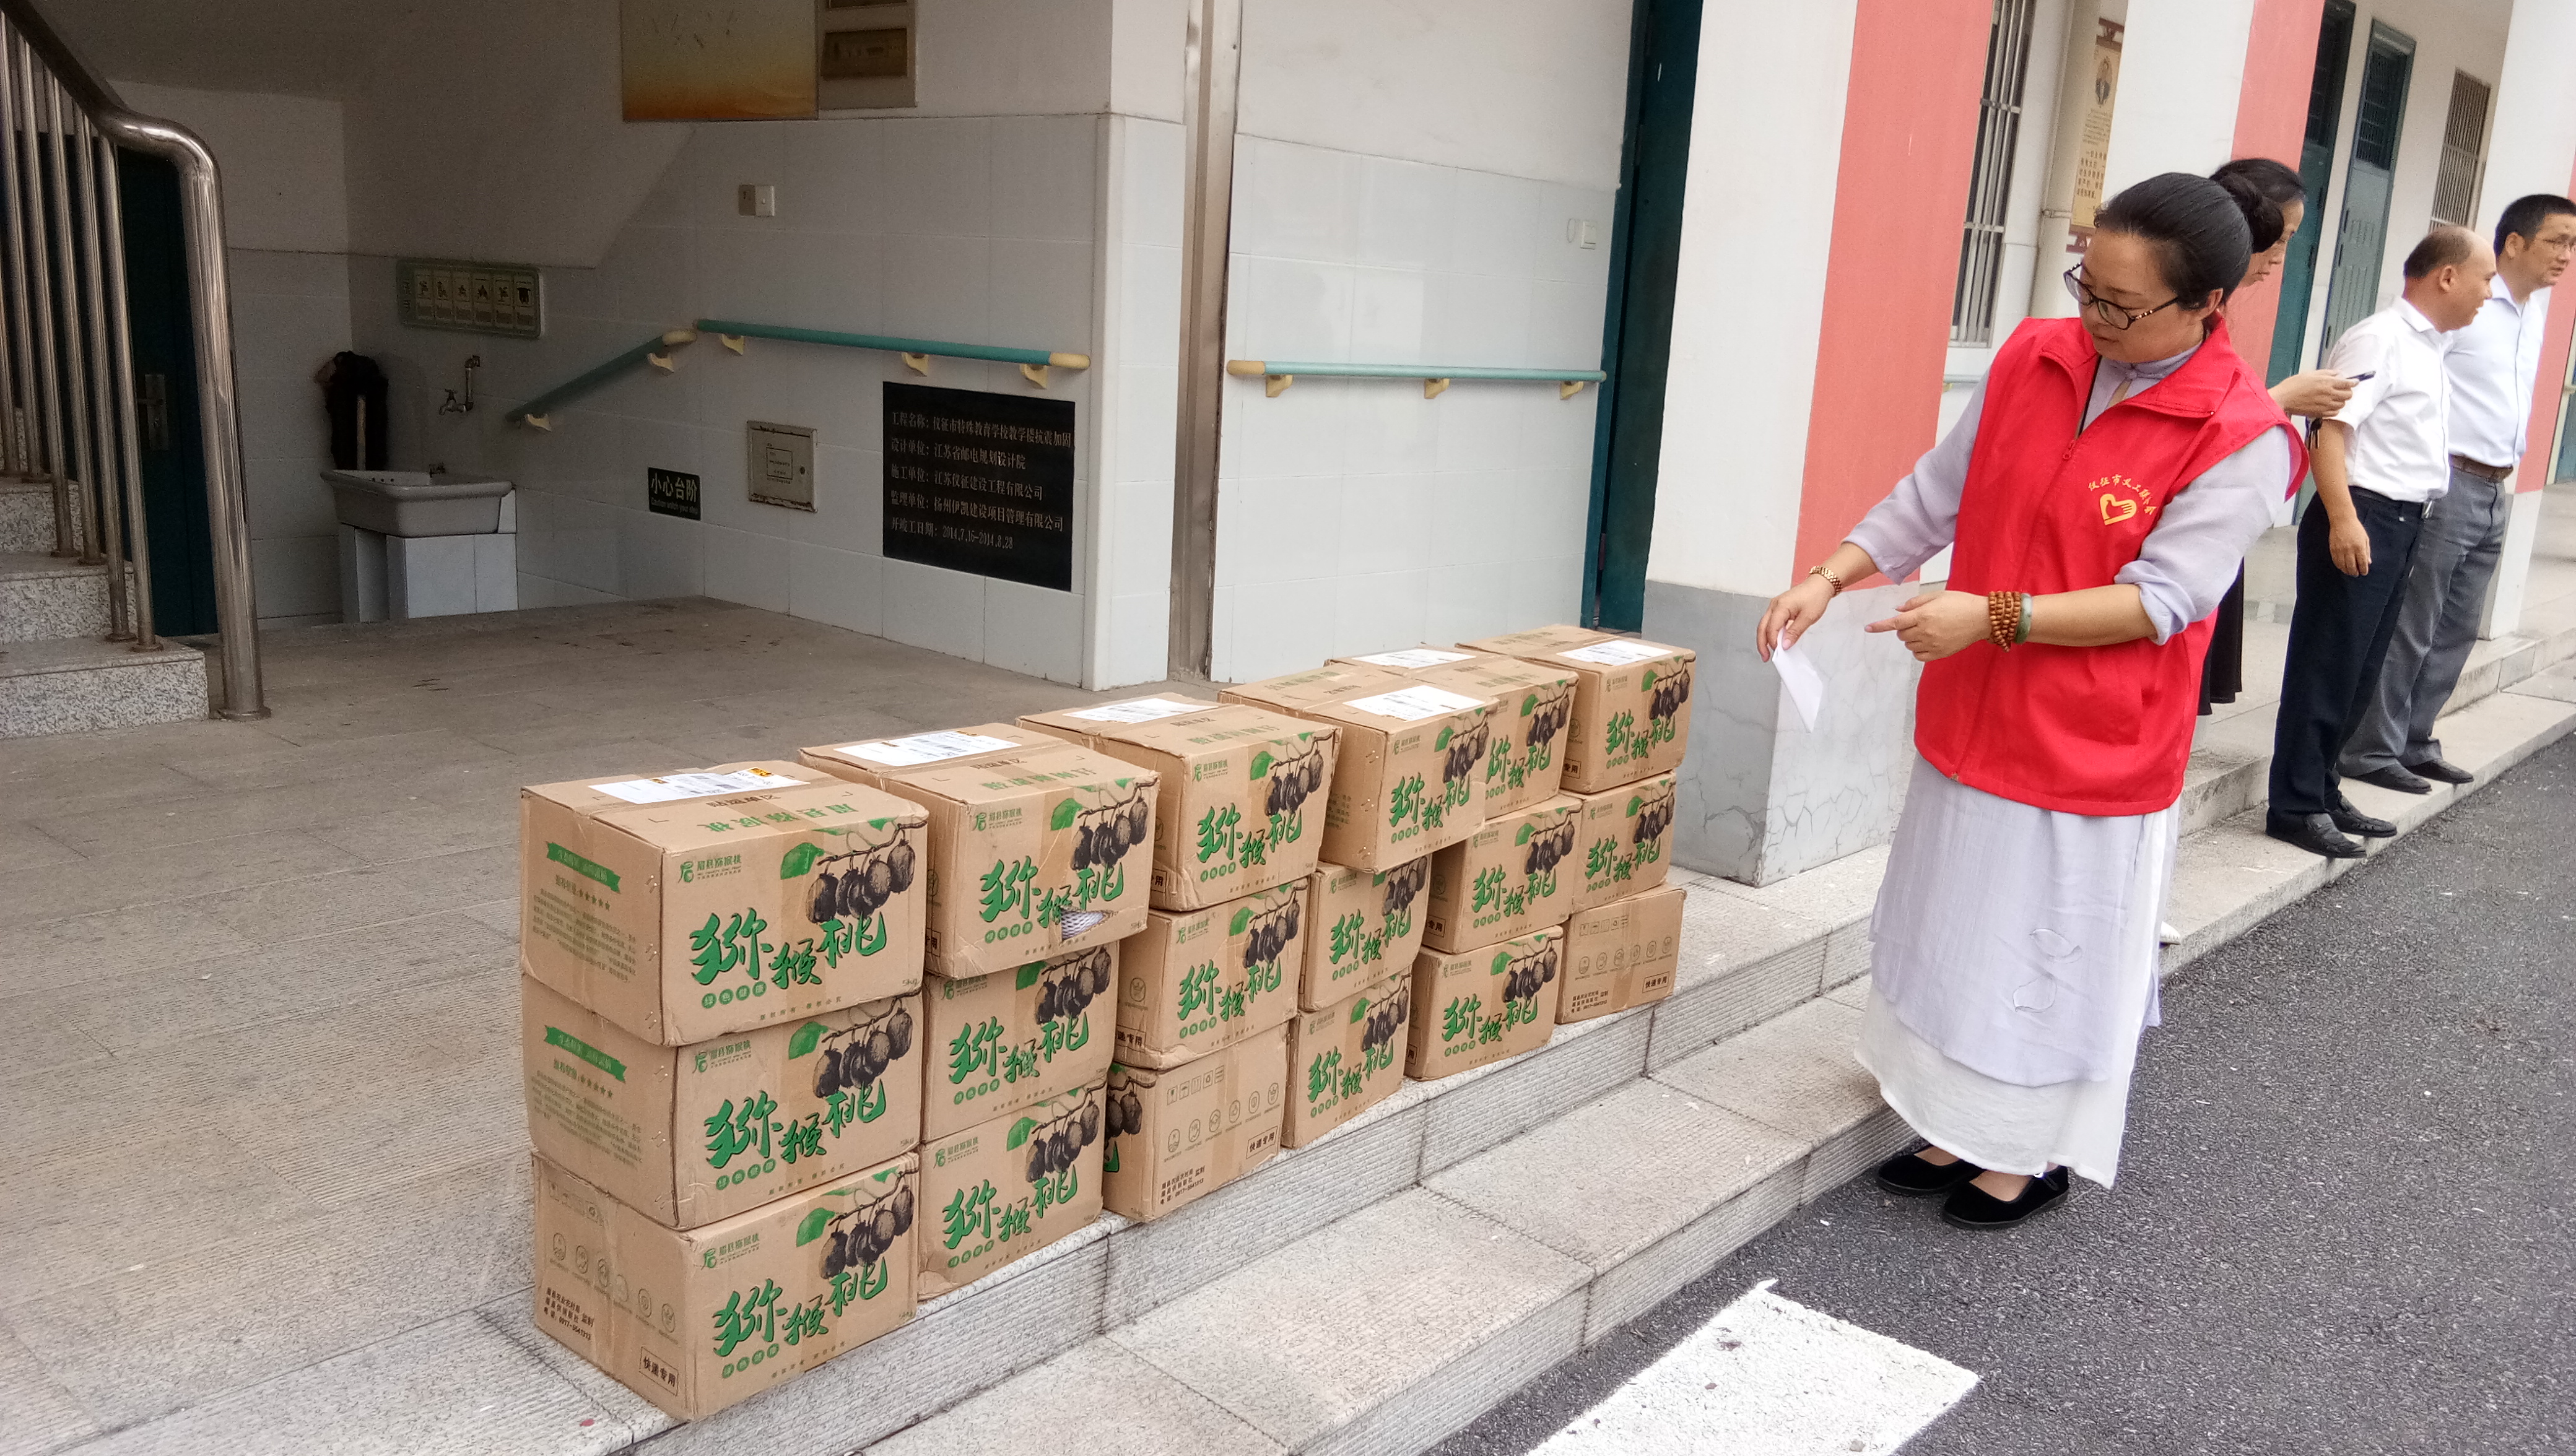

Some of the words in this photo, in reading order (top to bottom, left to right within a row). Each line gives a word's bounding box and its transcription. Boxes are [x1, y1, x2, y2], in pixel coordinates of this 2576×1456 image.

[651, 472, 697, 503] 小心台阶
[1605, 708, 1676, 760] 猕猴桃
[1388, 771, 1471, 831] 猕猴桃
[1196, 802, 1302, 868] 猕猴桃
[1585, 834, 1661, 883] 猕猴桃
[1471, 864, 1557, 917] 猕猴桃
[689, 907, 887, 989] 猕猴桃
[1329, 905, 1411, 964] 猕猴桃
[1177, 956, 1281, 1021] 猕猴桃
[948, 1012, 1089, 1085] 猕猴桃
[1442, 993, 1538, 1045] 猕猴桃
[1307, 1038, 1394, 1103] 猕猴桃
[703, 1079, 887, 1169] 猕猴桃
[1248, 1132, 1276, 1153] 快递专用
[942, 1164, 1078, 1249] 猕猴桃
[712, 1256, 888, 1357] 猕猴桃
[643, 1356, 676, 1387] 快递专用
